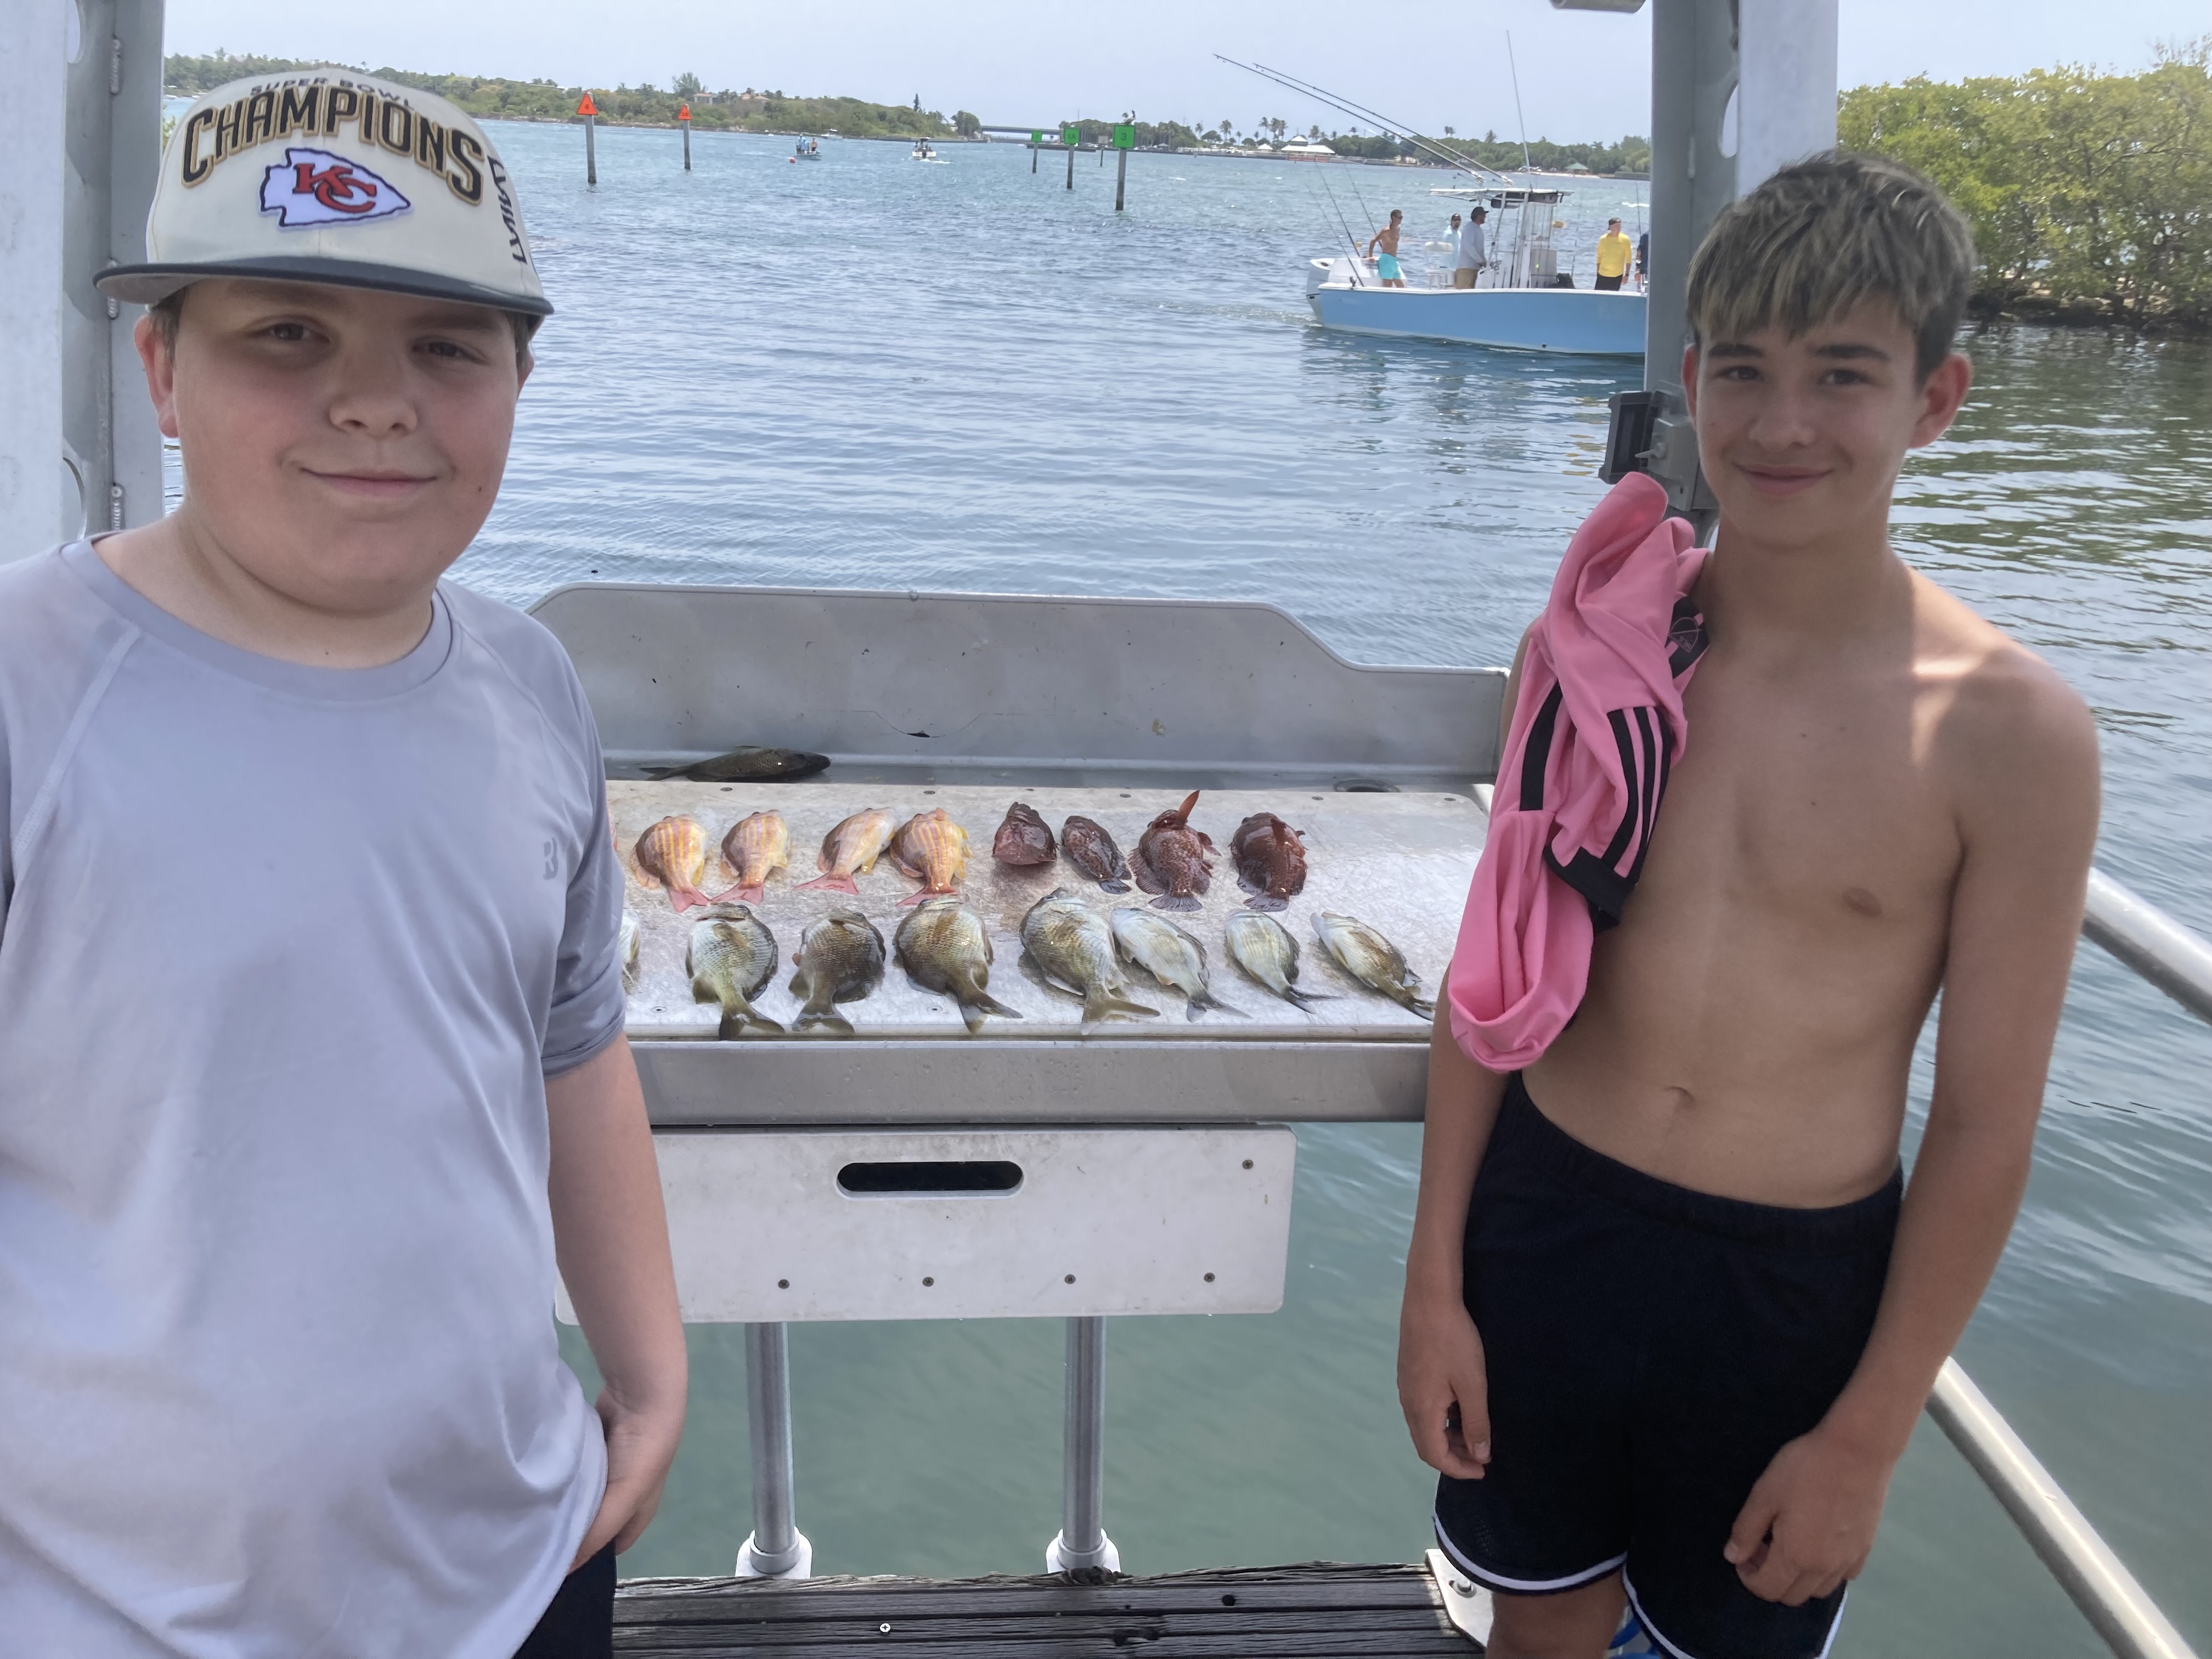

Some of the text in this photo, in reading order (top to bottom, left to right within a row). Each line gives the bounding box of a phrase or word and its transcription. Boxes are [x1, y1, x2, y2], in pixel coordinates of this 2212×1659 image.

[251, 77, 413, 106] SUPER BOWL
[182, 85, 484, 205] CHAMPIONS
[1121, 132, 1127, 140] 3
[292, 162, 377, 213] KC
